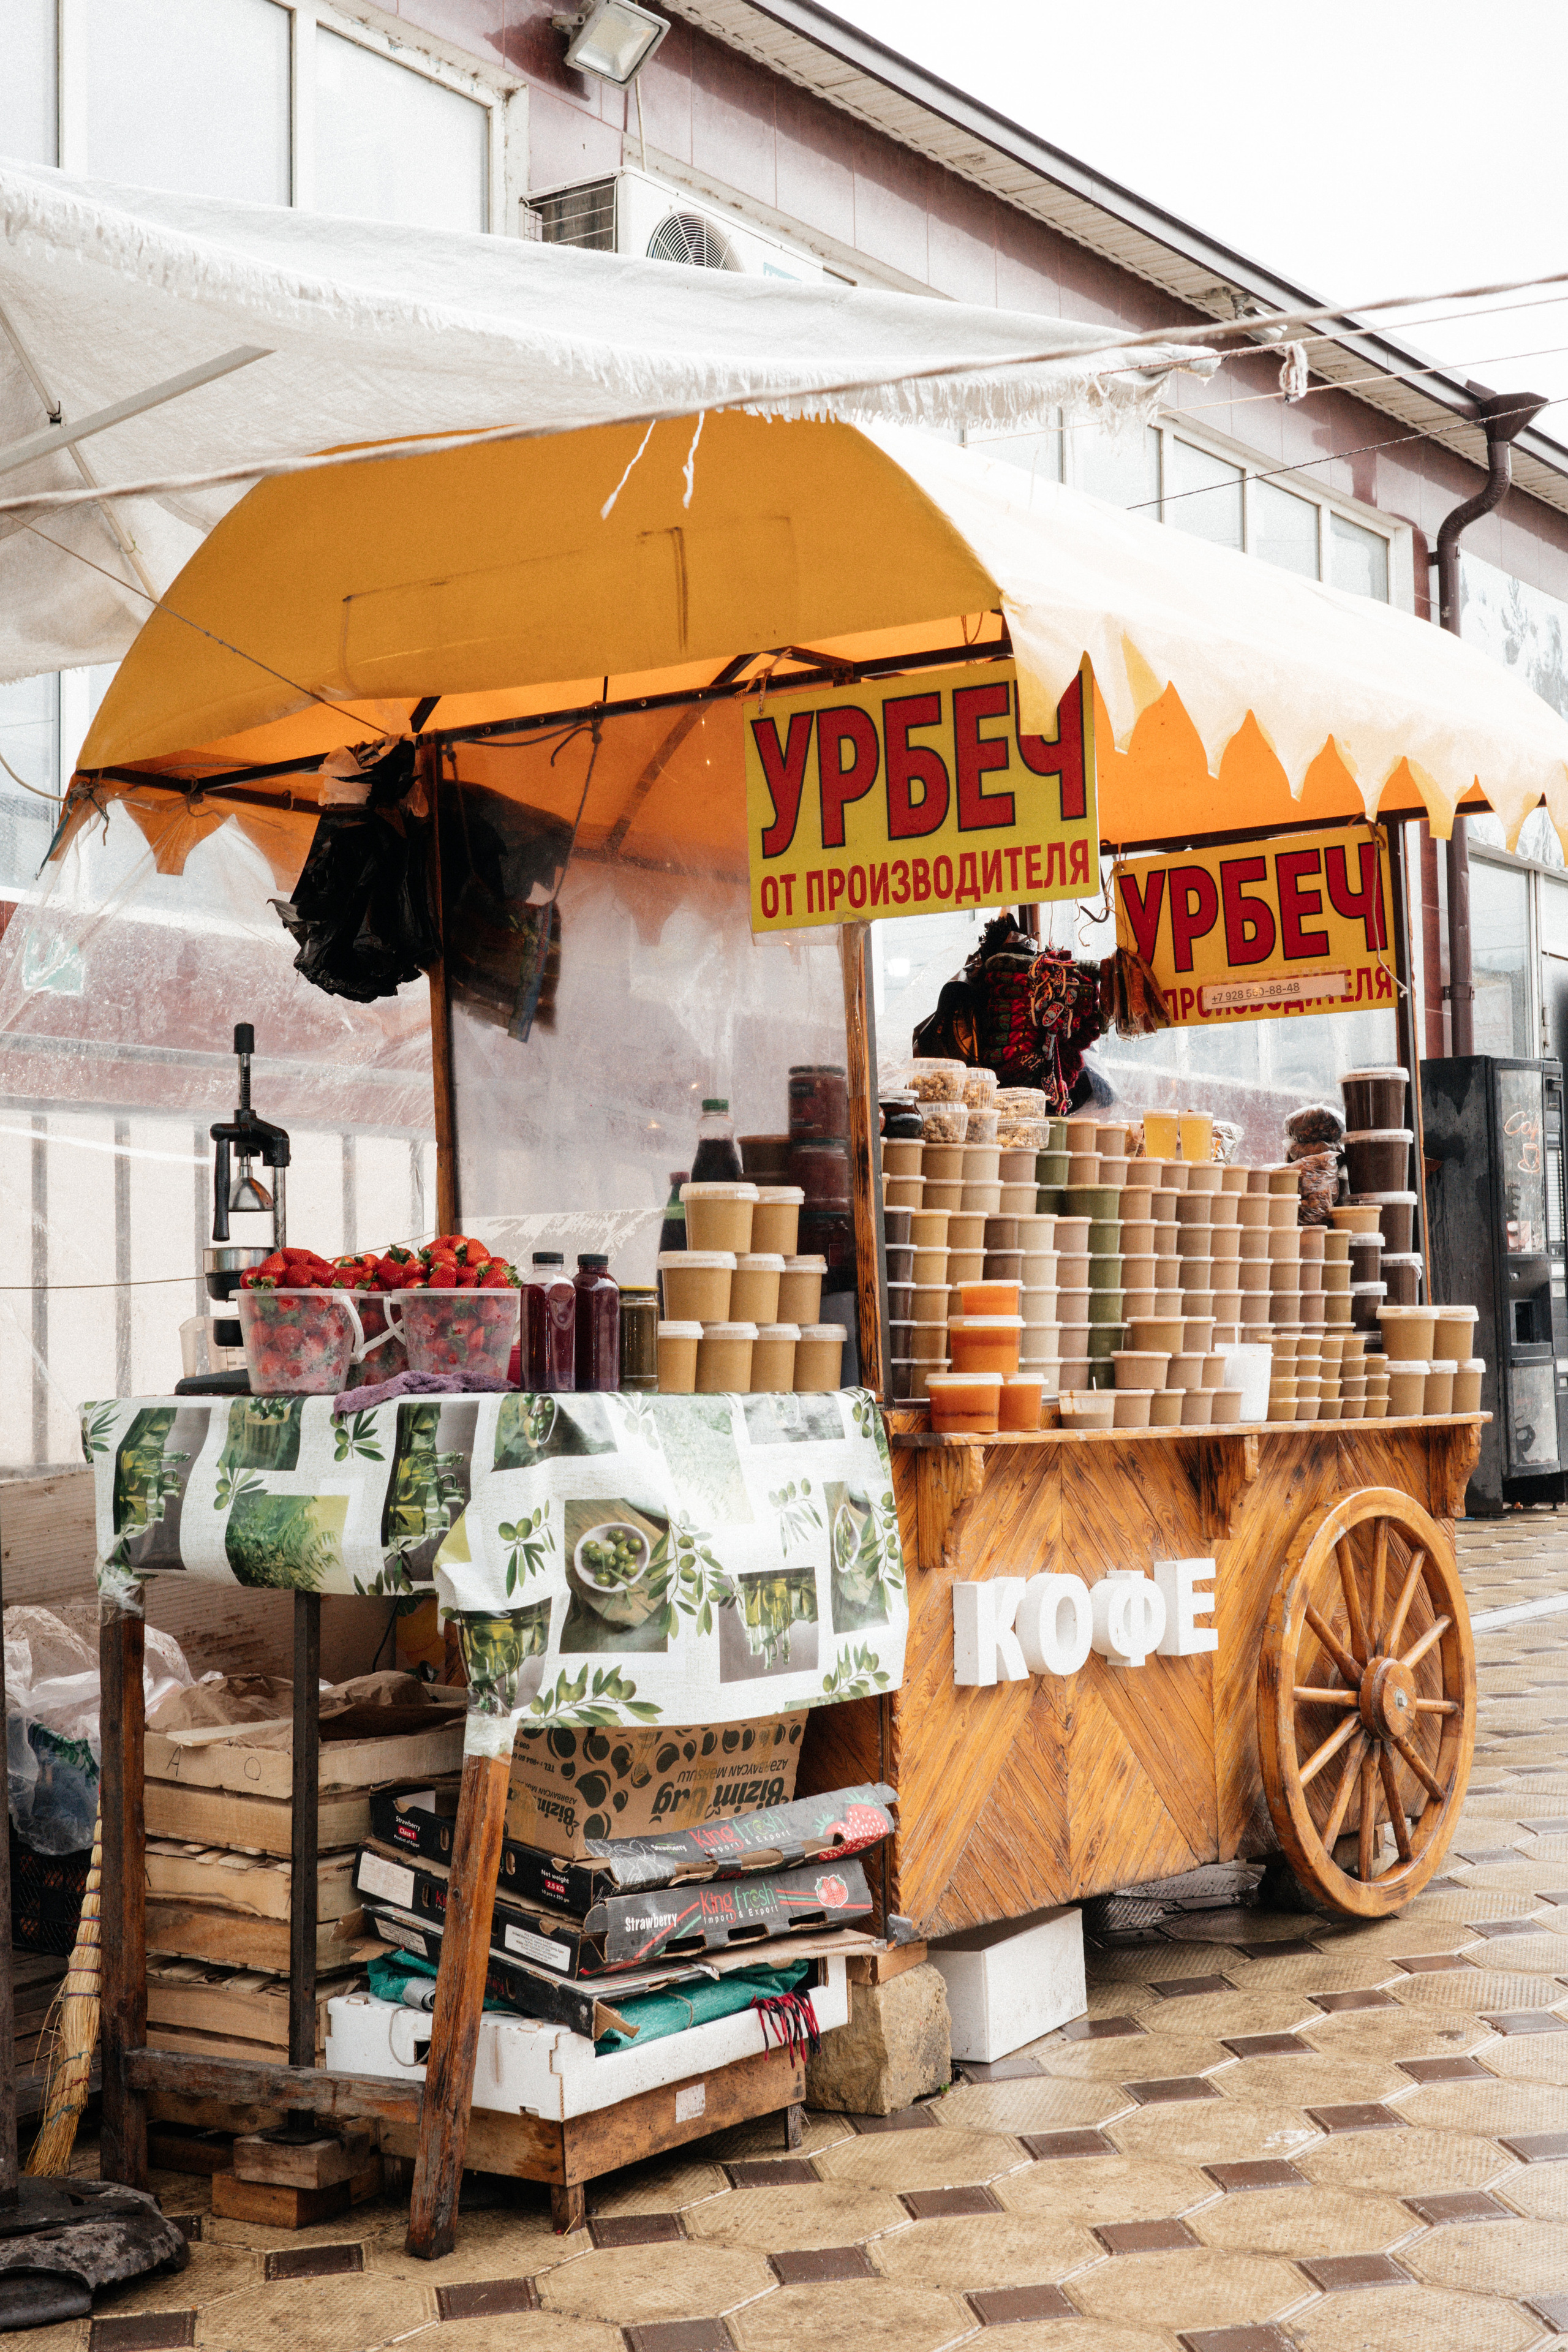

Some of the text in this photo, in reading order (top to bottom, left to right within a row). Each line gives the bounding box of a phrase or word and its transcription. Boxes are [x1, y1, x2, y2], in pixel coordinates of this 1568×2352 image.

[750, 669, 1087, 859] УРБЕЧ
[761, 839, 1090, 919] ОТ ПРОИЗВОДИТЕЛЯ
[1117, 841, 1389, 973] УРБЕЧ
[1226, 990, 1243, 1001] 928
[952, 1558, 1218, 1686] КОФЕ
[545, 1762, 554, 1773] TEL
[713, 1777, 785, 1813] Bizim
[396, 1815, 421, 1832] Strawberry
[399, 1828, 411, 1837] Class
[688, 1824, 744, 1850] King
[705, 1841, 741, 1854] Import
[755, 1830, 791, 1843] Export
[651, 1844, 687, 1852] Strawberry
[541, 1869, 569, 1884] Net weight
[700, 1890, 736, 1923] King
[704, 1912, 733, 1924] Import
[748, 1905, 779, 1917] Export
[625, 1913, 677, 1932] Strawberry
